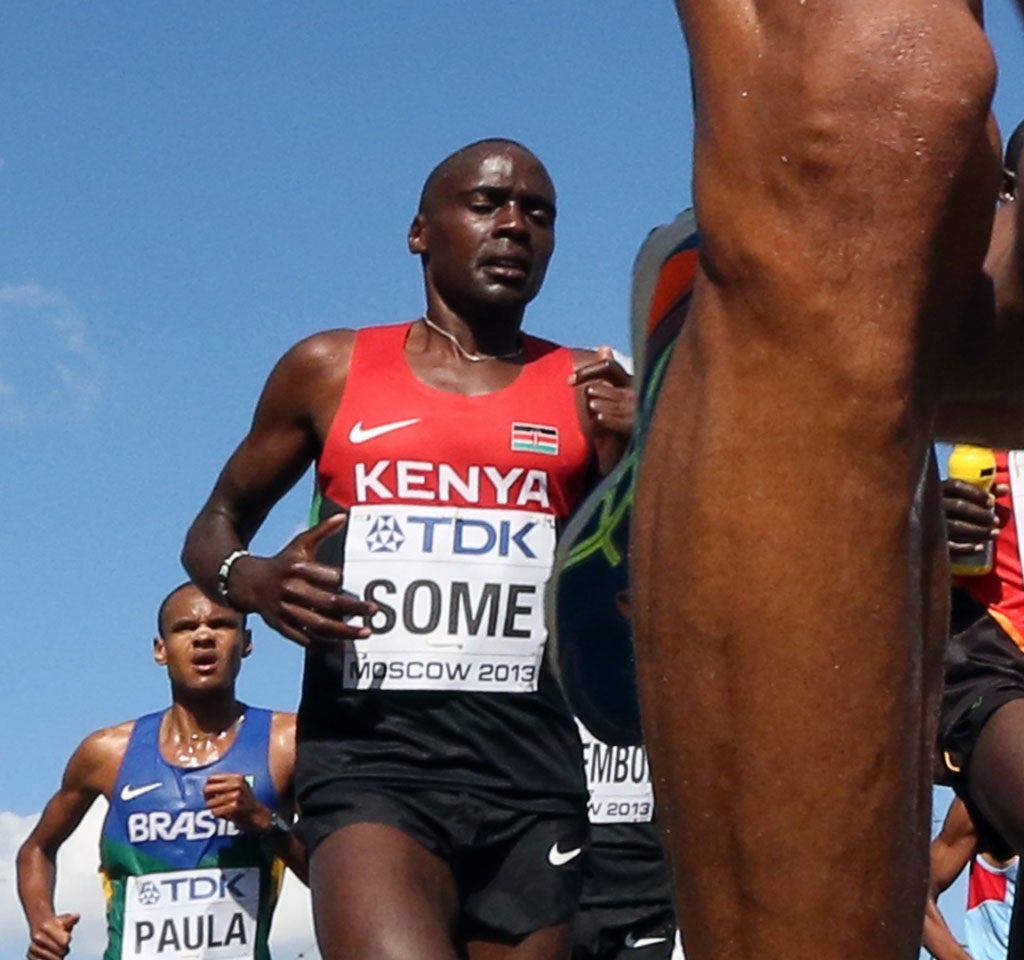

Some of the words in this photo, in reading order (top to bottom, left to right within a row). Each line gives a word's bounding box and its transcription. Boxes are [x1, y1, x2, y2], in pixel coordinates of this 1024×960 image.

[354, 460, 550, 507] KENYA
[407, 515, 538, 560] TDK
[363, 578, 537, 638] SOME
[350, 661, 472, 681] MOSCOW
[478, 664, 536, 683] 2013
[607, 802, 651, 816] 2013
[161, 873, 246, 902] TDK
[134, 912, 247, 954] PAULA
